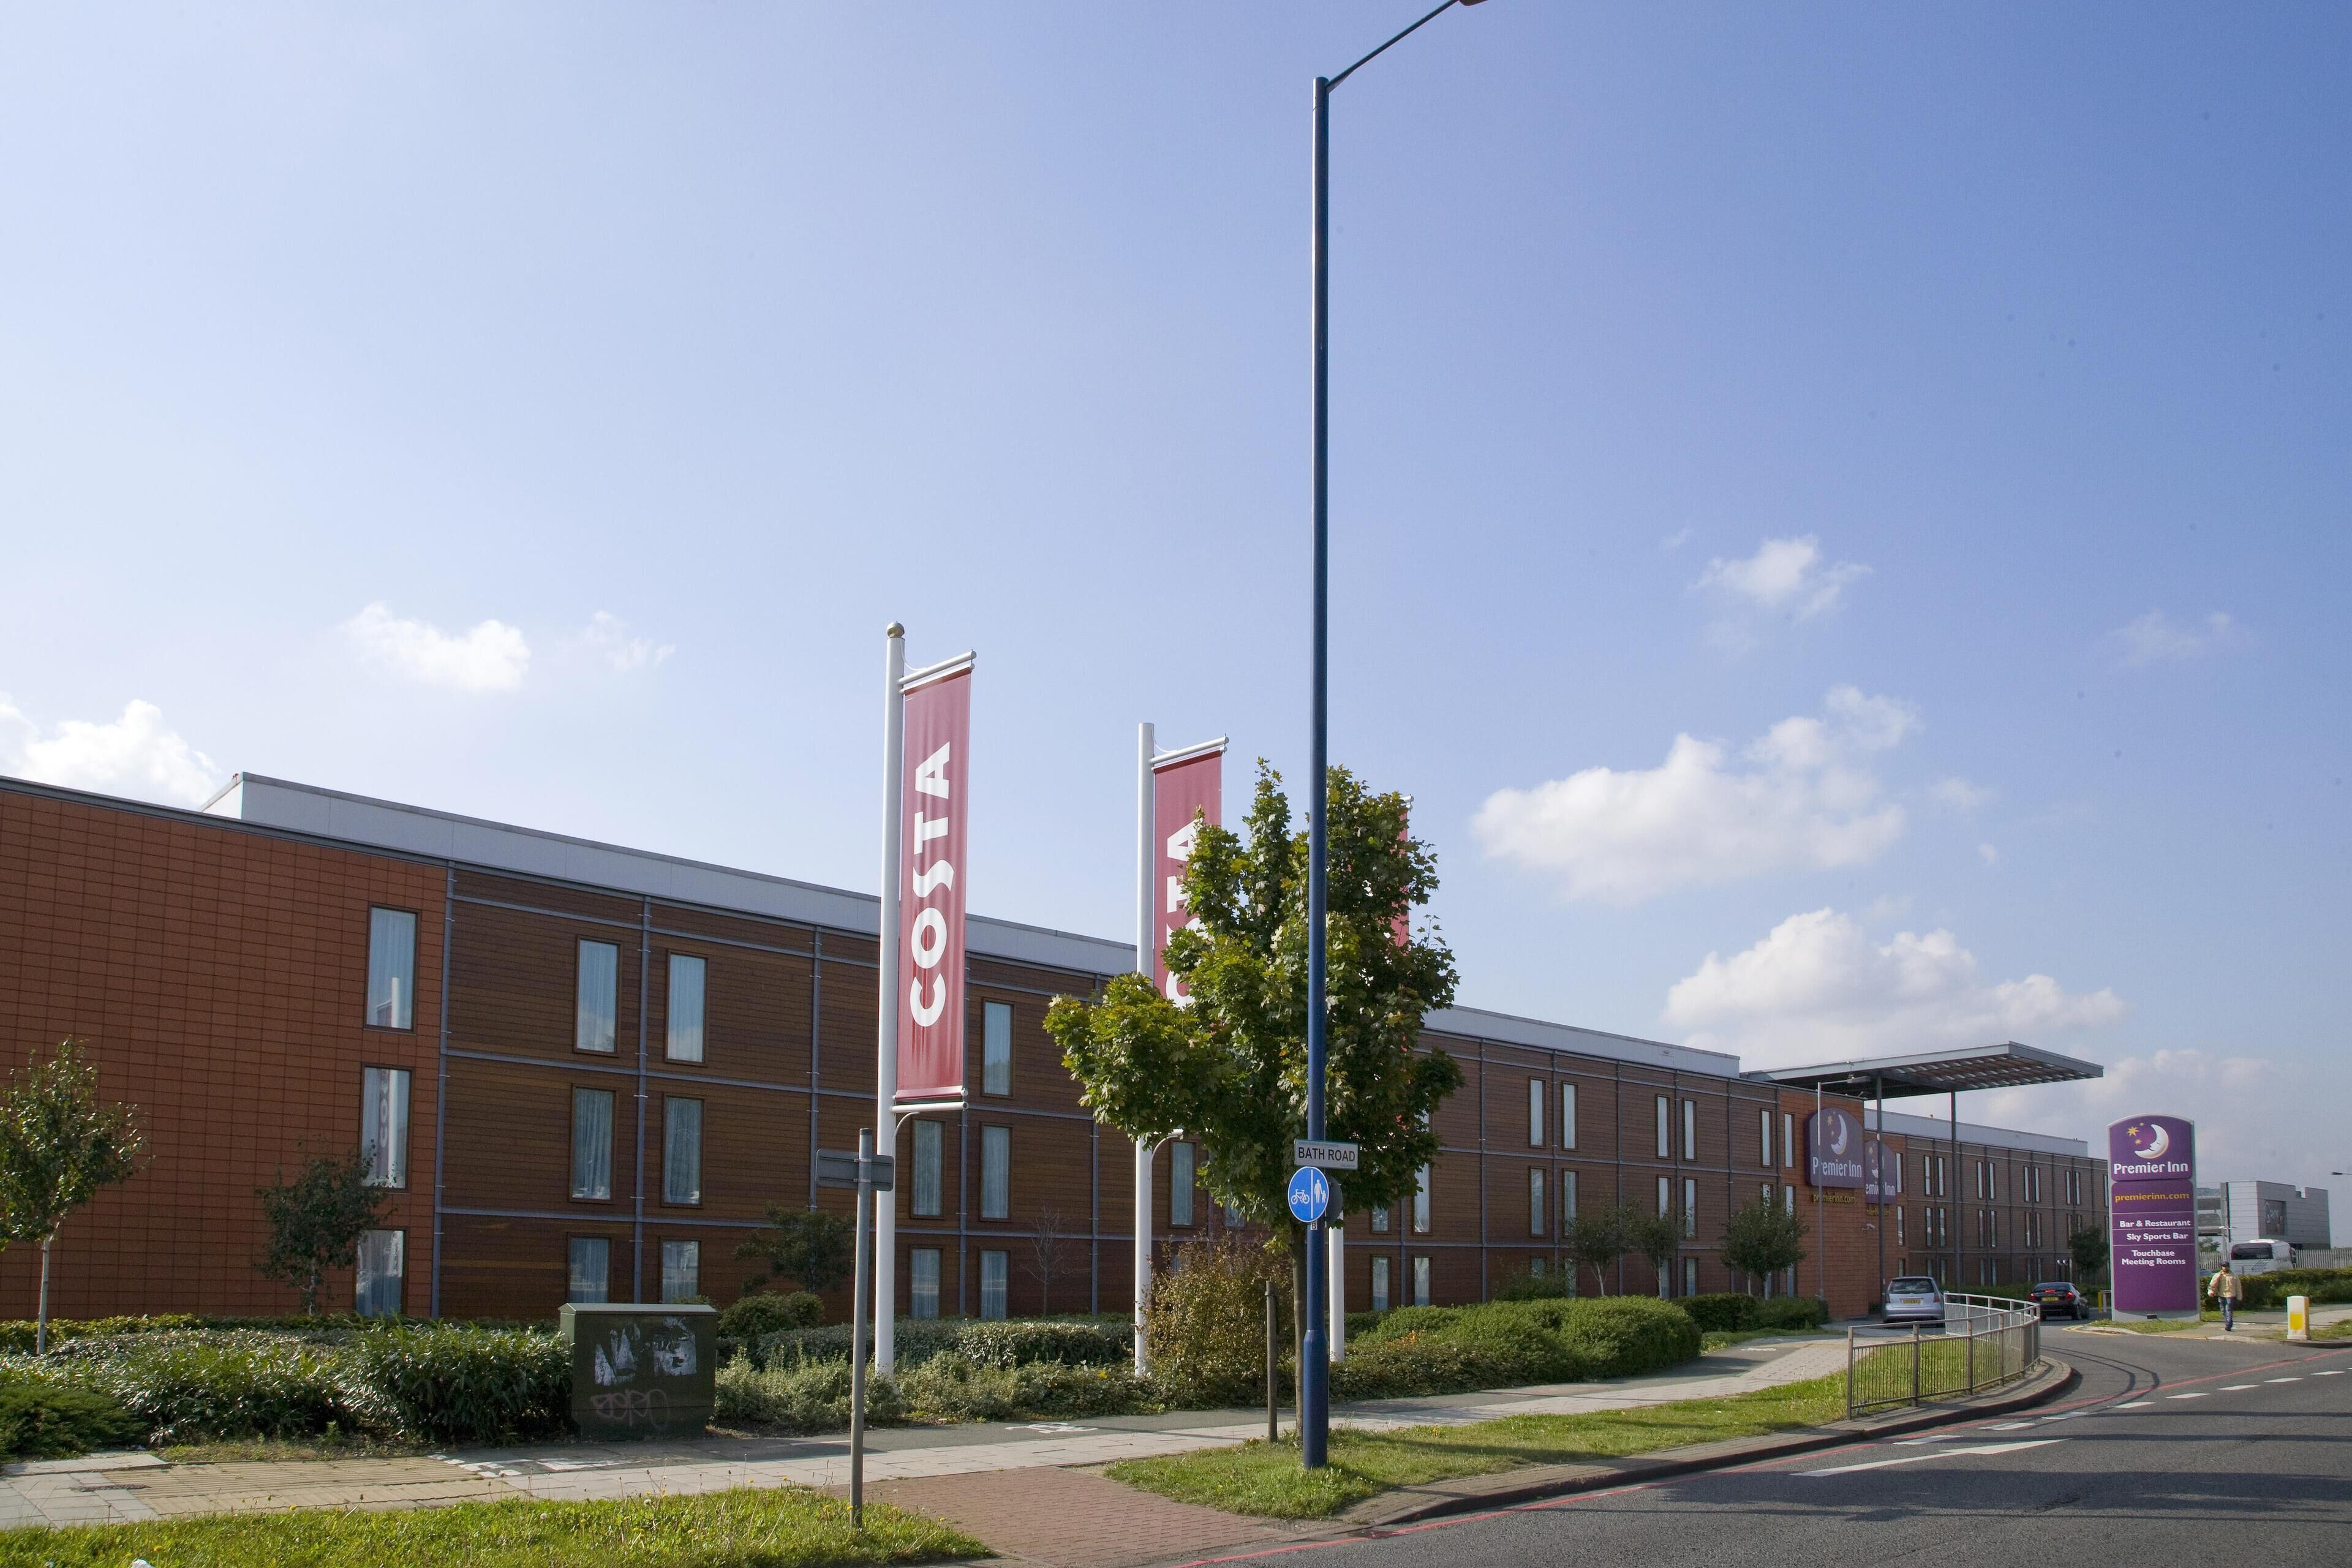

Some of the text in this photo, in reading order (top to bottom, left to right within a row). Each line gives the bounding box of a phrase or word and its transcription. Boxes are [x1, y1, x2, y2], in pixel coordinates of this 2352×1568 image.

[910, 741, 954, 1027] COSTA
[1298, 1147, 1355, 1162] BATH ROAD
[1812, 1156, 1862, 1177] Pemier Inn
[2114, 1161, 2188, 1174] Premier Inn
[1885, 1182, 1895, 1196] Inn
[2114, 1193, 2190, 1203] premierinn.com
[2126, 1233, 2141, 1242] Sky
[2143, 1233, 2171, 1242] Sports
[2121, 1258, 2155, 1267] Meeting
